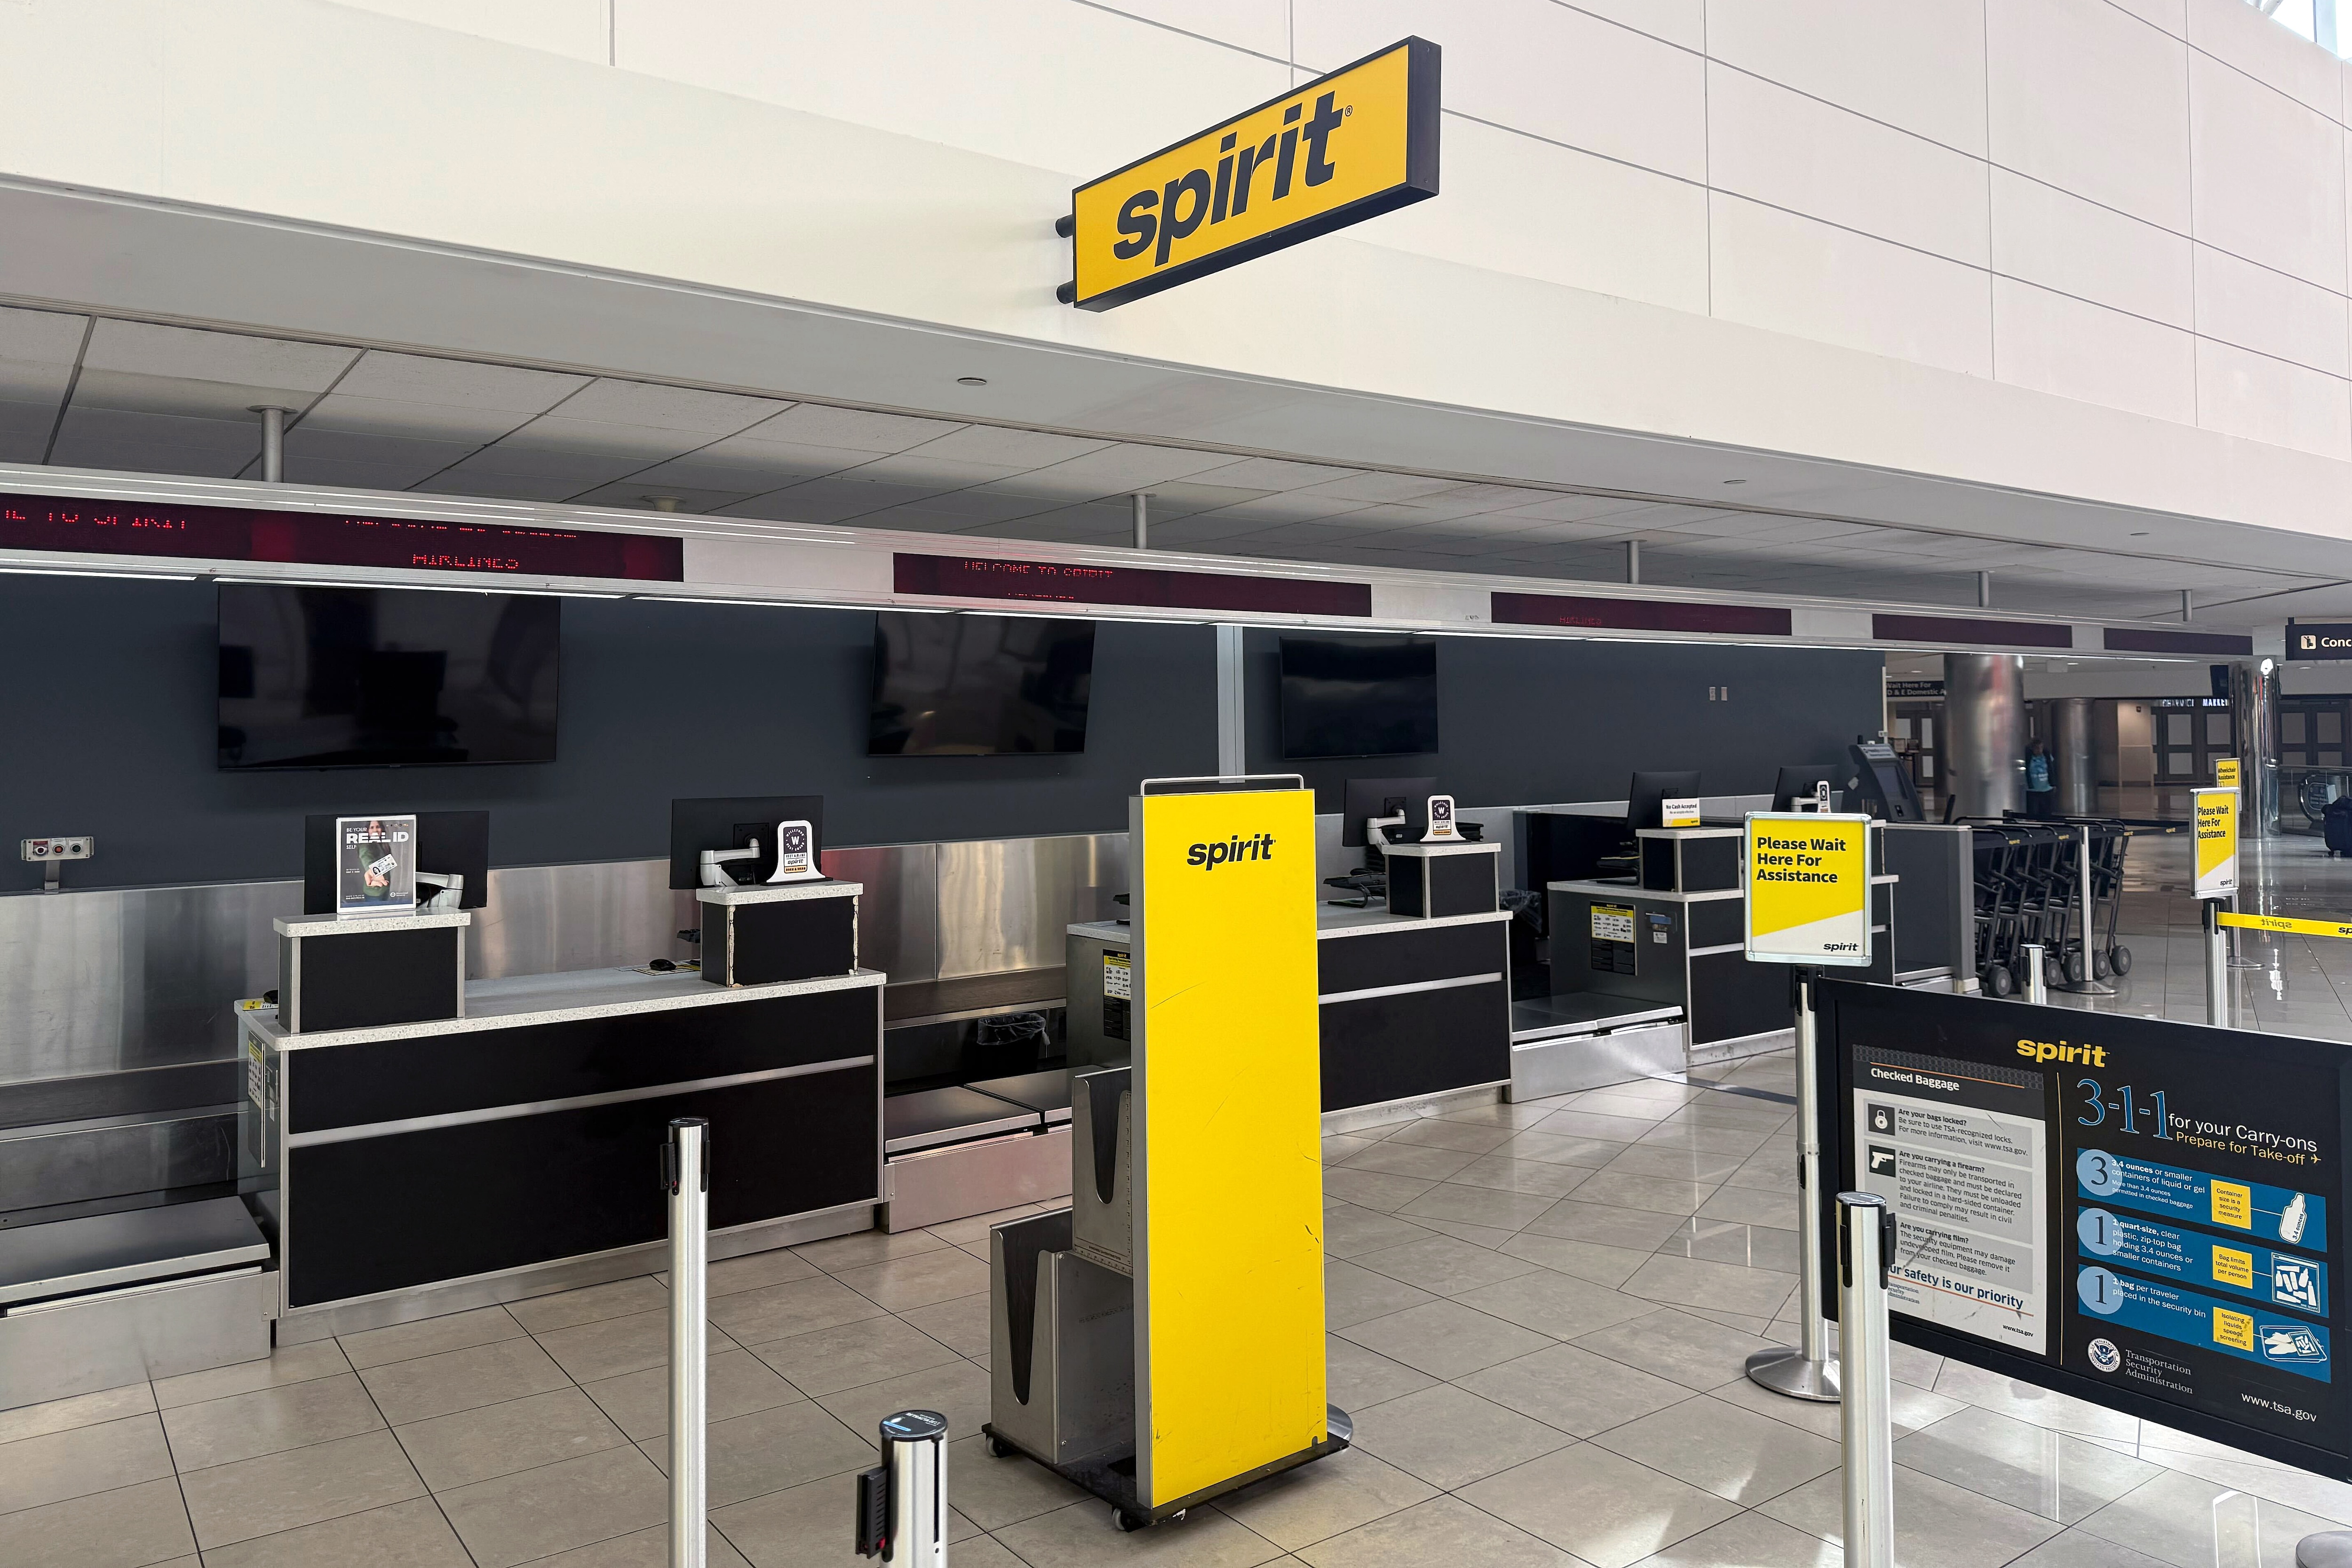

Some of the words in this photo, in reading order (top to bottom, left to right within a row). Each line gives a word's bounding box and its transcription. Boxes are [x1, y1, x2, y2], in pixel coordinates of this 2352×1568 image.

[1113, 90, 1344, 267] spirit
[2198, 806, 2215, 816] Please
[2216, 805, 2229, 815] Wait
[2198, 819, 2210, 828] Here
[2211, 818, 2221, 827] For
[346, 832, 391, 844] REAL
[393, 831, 409, 843] ID
[1756, 836, 1807, 850] Please
[1810, 838, 1846, 852] Wait
[2198, 829, 2225, 839] Assistance
[1186, 833, 1274, 871] spirit
[1757, 852, 1793, 866] Here
[1796, 854, 1822, 867] For
[1756, 868, 1838, 883] Assistance
[1823, 942, 1859, 952] spirit
[2016, 1039, 2107, 1068] spirit
[1870, 1067, 1913, 1083] Checked
[1915, 1074, 1960, 1091] Baggage
[1926, 1113, 1942, 1122] bags
[1942, 1115, 1967, 1126] locked?
[2076, 1078, 2173, 1140] 3-1-1
[1910, 1128, 1927, 1136] more
[1928, 1130, 1967, 1145] information,
[1968, 1138, 1983, 1147] visit
[1984, 1142, 2028, 1156] www.tsa.gov.
[1942, 1124, 1993, 1140] TSA-recognized
[1994, 1134, 2013, 1144] locks.
[2168, 1113, 2191, 1129] for
[2194, 1120, 2231, 1136] your
[2236, 1124, 2317, 1156] Carry-ons
[2176, 1130, 2225, 1150] Prepare
[2228, 1140, 2247, 1154] for
[2250, 1144, 2305, 1165] Take-off
[1899, 1150, 1911, 1158] Are
[1924, 1155, 1951, 1167] carrying
[1957, 1162, 1985, 1173] firearm?
[2090, 1156, 2108, 1186] 3
[2111, 1159, 2124, 1167] 3.4
[2125, 1163, 2153, 1173] ounces
[2164, 1171, 2192, 1181] smaller
[1899, 1158, 1927, 1170] Firearms
[1927, 1165, 1942, 1174] may
[1942, 1168, 1957, 1177] only
[1958, 1170, 1967, 1178] be
[1968, 1173, 2006, 1187] transported
[2008, 1180, 2014, 1189] in
[2111, 1169, 2150, 1182] containers
[2161, 1178, 2181, 1188] liquid
[2112, 1186, 2137, 1197] permitted
[2145, 1194, 2168, 1203] checked
[2169, 1199, 2193, 1209] baggage
[2216, 1187, 2242, 1198] Container
[2218, 1210, 2242, 1219] measure
[2219, 1203, 2241, 1212] security
[1899, 1221, 1912, 1230] Are
[1912, 1225, 1924, 1233] you
[1924, 1228, 1952, 1241] carrying
[1952, 1234, 1969, 1244] film?
[2095, 1215, 2107, 1246] 1
[2112, 1229, 2138, 1241] plastic,
[2140, 1235, 2165, 1247] zip-top
[2167, 1241, 2181, 1252] bag
[2119, 1221, 2159, 1236] quart-size,
[2161, 1231, 2178, 1240] clear
[2113, 1238, 2140, 1252] holding
[2141, 1245, 2153, 1254] 3.4
[2155, 1250, 2183, 1261] ounces
[2218, 1253, 2230, 1262] Bag
[2230, 1256, 2245, 1265] limits
[2112, 1250, 2139, 1260] smaller
[2141, 1257, 2181, 1271] containers
[2228, 1264, 2249, 1273] volume
[2228, 1271, 2247, 1280] person
[1888, 1263, 1902, 1275] ur
[1904, 1265, 1939, 1287] safety
[1942, 1275, 1951, 1289] is
[1954, 1282, 1974, 1295] our
[1977, 1288, 2024, 1310] priority
[2095, 1274, 2107, 1305] 1
[2120, 1279, 2135, 1290] bag
[2150, 1288, 2179, 1300] traveler
[2113, 1289, 2137, 1299] placed
[2148, 1297, 2160, 1305] the
[2161, 1302, 2192, 1315] security
[2194, 1308, 2205, 1318] bin
[2221, 1312, 2245, 1324] Isolating
[2224, 1320, 2242, 1329] liquids
[2002, 1324, 2034, 1337] www.tsa.gov
[2219, 1334, 2247, 1346] screening
[2223, 1328, 2243, 1337] speeds
[2125, 1348, 2191, 1376] Transportation
[2125, 1358, 2162, 1378] Security
[2125, 1367, 2193, 1394] Administration
[2241, 1393, 2317, 1422] www.tsa.gov
